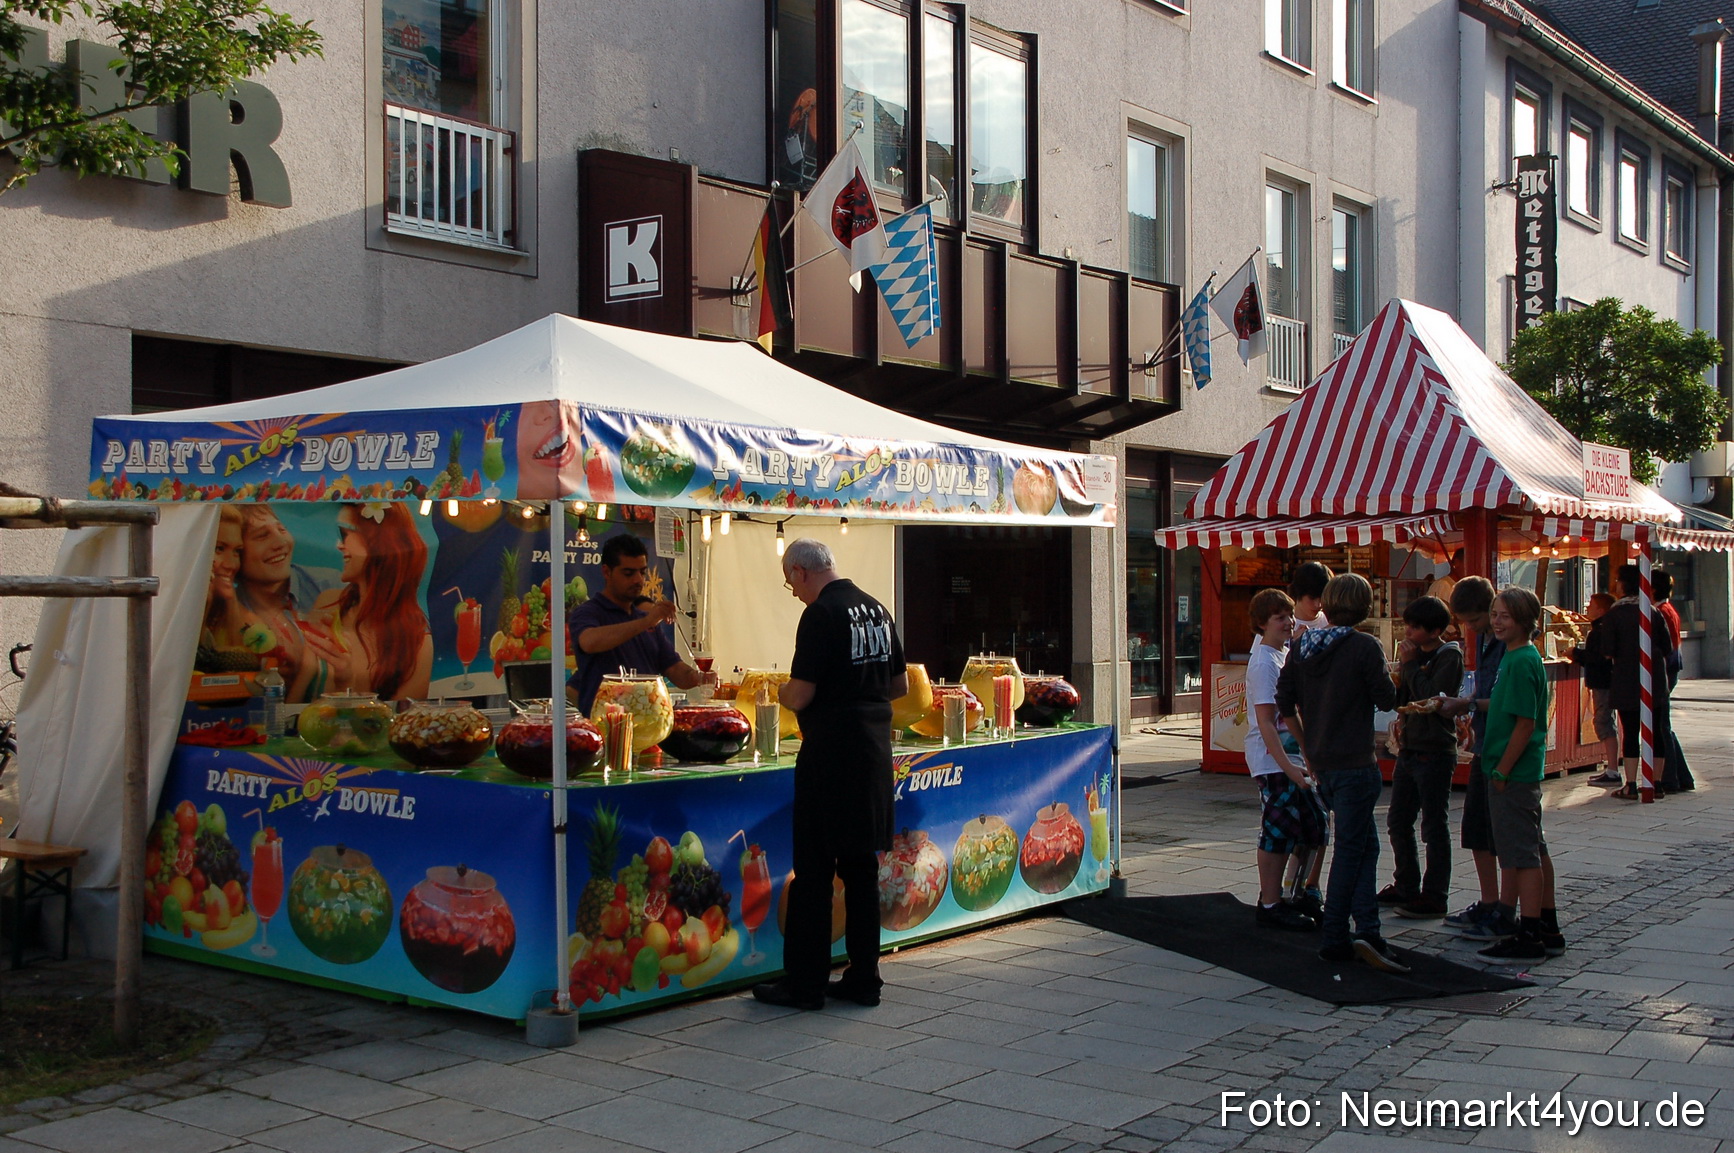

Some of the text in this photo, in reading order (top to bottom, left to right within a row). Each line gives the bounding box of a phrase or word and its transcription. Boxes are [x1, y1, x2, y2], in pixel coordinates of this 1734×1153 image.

[609, 221, 659, 287] K
[102, 439, 221, 474] PARTY
[300, 430, 440, 472] BOWLE
[1592, 450, 1620, 470] DIE KLEINE
[713, 445, 836, 488] PARTY
[895, 458, 990, 497] BOWLE
[1103, 471, 1112, 483] 30
[1585, 469, 1629, 497] BACKSTUBE
[531, 550, 577, 564] PATY
[909, 765, 963, 792] BOWLE
[206, 769, 272, 799] PARTY
[338, 787, 416, 820] BOWLE
